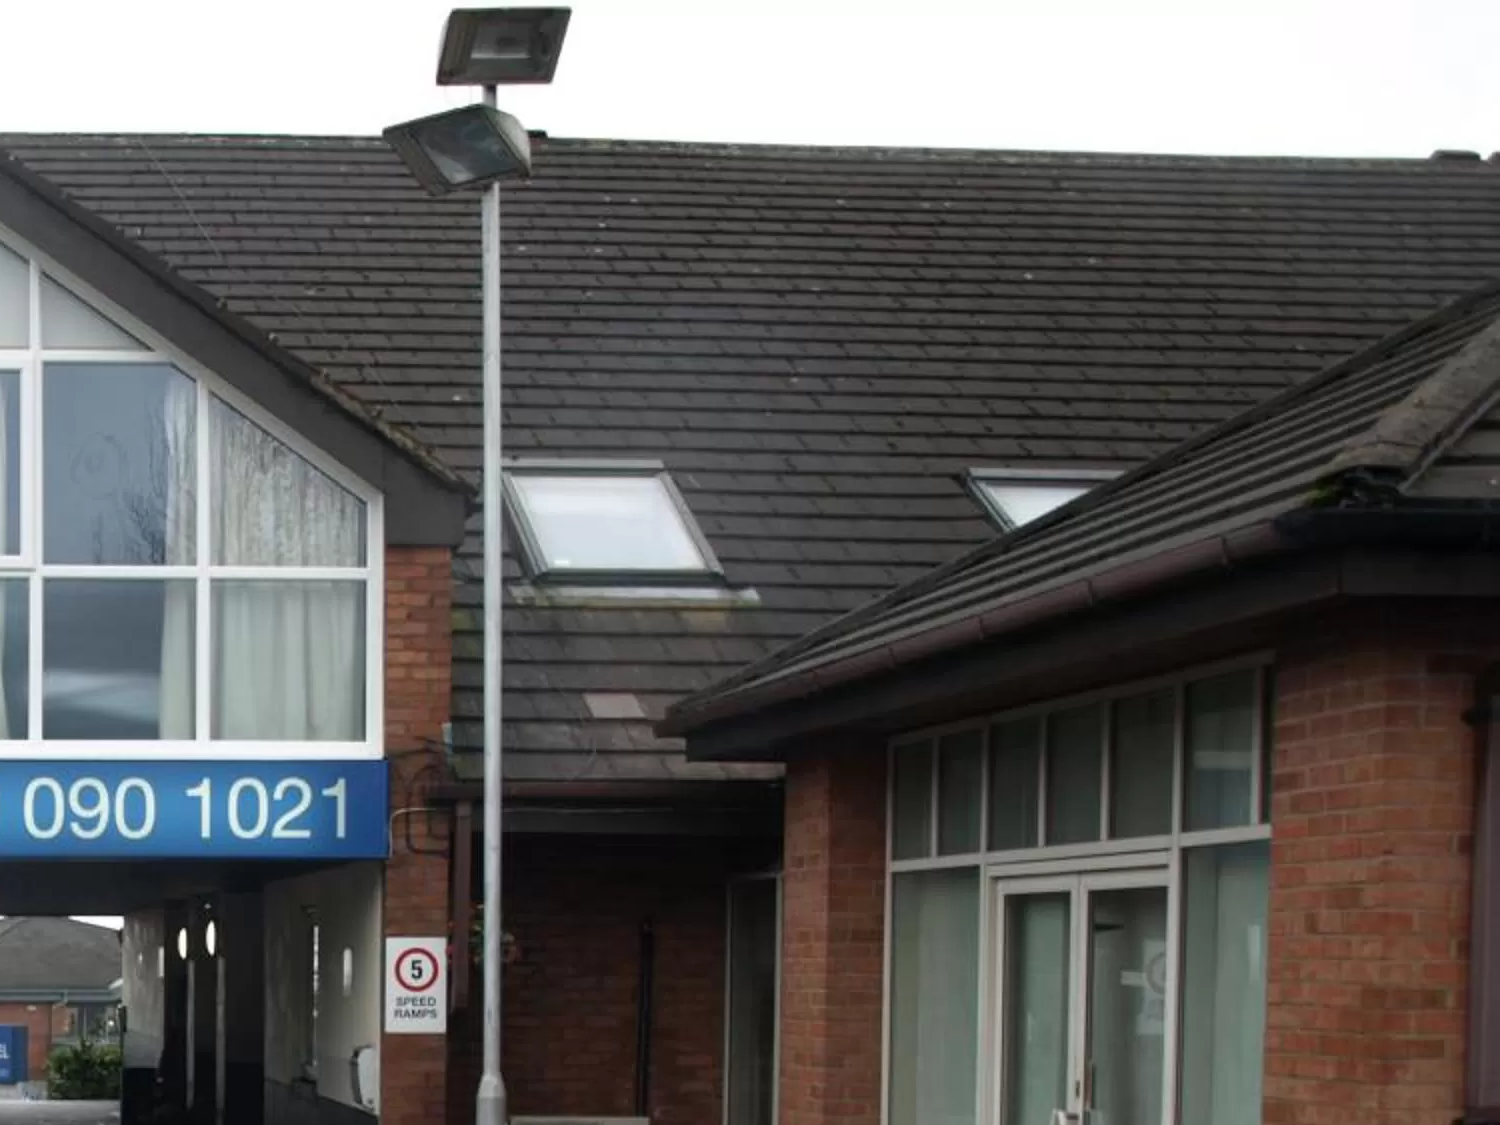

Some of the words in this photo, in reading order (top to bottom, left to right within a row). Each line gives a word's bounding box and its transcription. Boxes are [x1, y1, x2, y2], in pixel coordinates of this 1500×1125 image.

[23, 777, 157, 841] 090
[185, 777, 348, 840] 1021
[411, 959, 423, 979] 5
[395, 996, 436, 1006] SPEED
[394, 1008, 437, 1018] RAMPS
